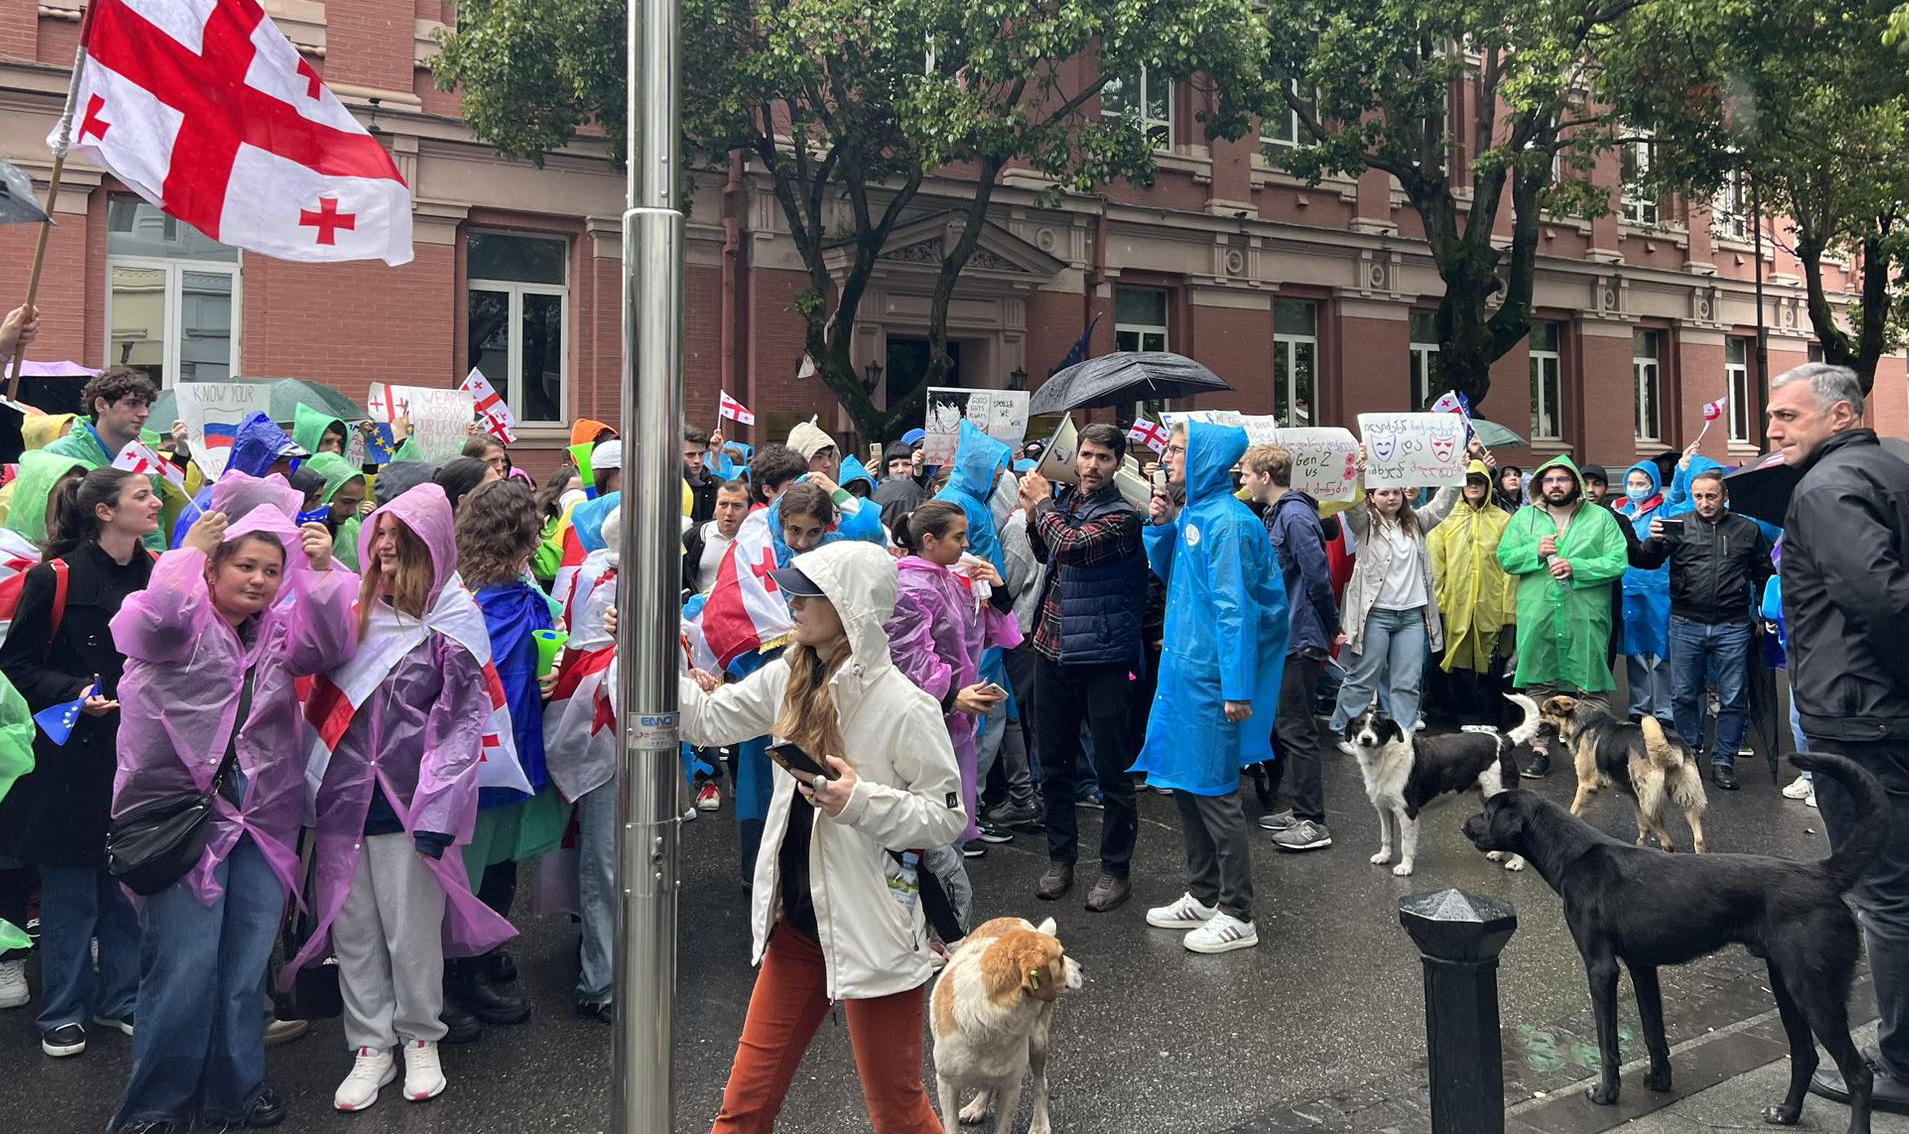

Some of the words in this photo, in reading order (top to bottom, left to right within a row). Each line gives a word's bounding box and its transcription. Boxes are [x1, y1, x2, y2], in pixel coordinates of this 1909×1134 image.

[192, 385, 226, 402] KNOW
[231, 385, 254, 402] YOUR
[420, 390, 441, 406] WE
[444, 391, 466, 408] ARE
[416, 418, 434, 435] OUR
[1296, 452, 1317, 467] Gen
